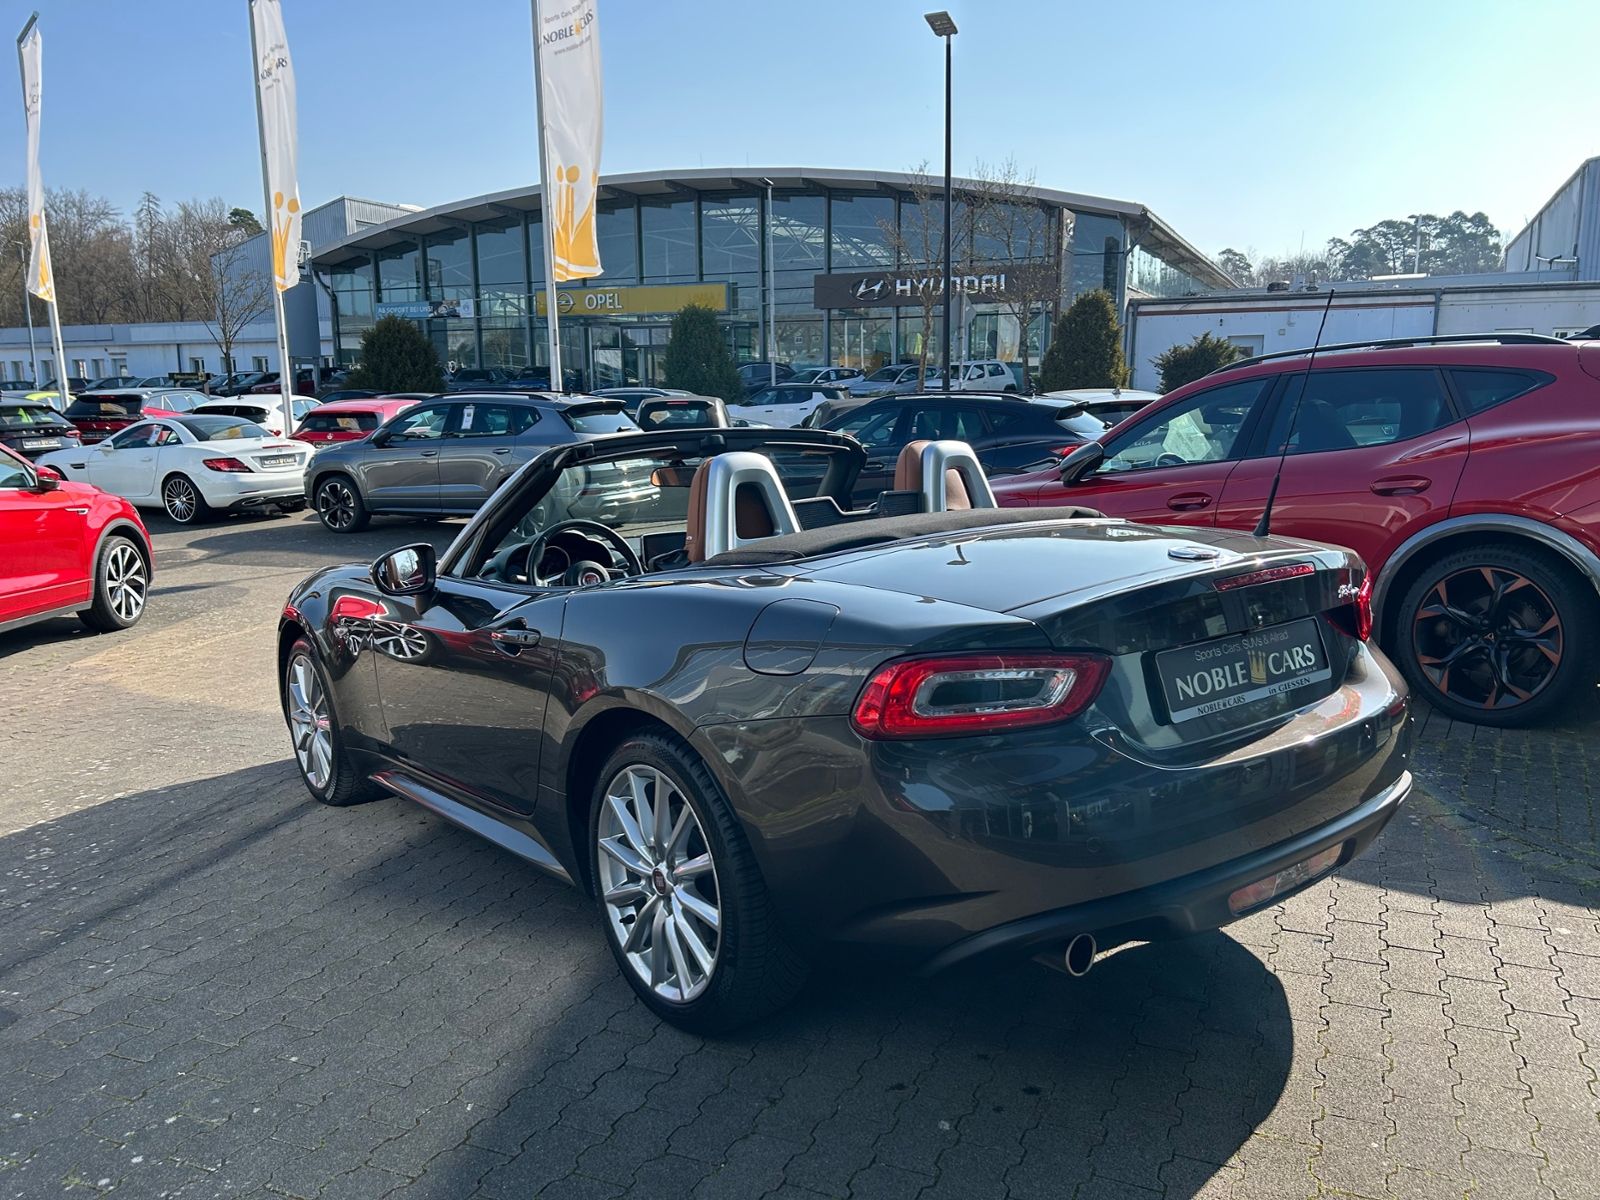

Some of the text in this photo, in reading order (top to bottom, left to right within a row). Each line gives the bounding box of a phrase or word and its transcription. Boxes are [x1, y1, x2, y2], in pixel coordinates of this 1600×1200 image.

[543, 24, 574, 44] NOBLE
[895, 273, 1006, 297] HYUNDAI
[585, 293, 623, 310] OPEL
[1194, 647, 1222, 662] Sports
[1241, 637, 1263, 650] SUVs
[1263, 634, 1269, 645] &
[1269, 630, 1289, 643] Allrad
[1175, 643, 1316, 701] NOBLE CARS
[1268, 676, 1311, 695] in GIESSEN
[1197, 694, 1246, 716] NOBLE CARS
